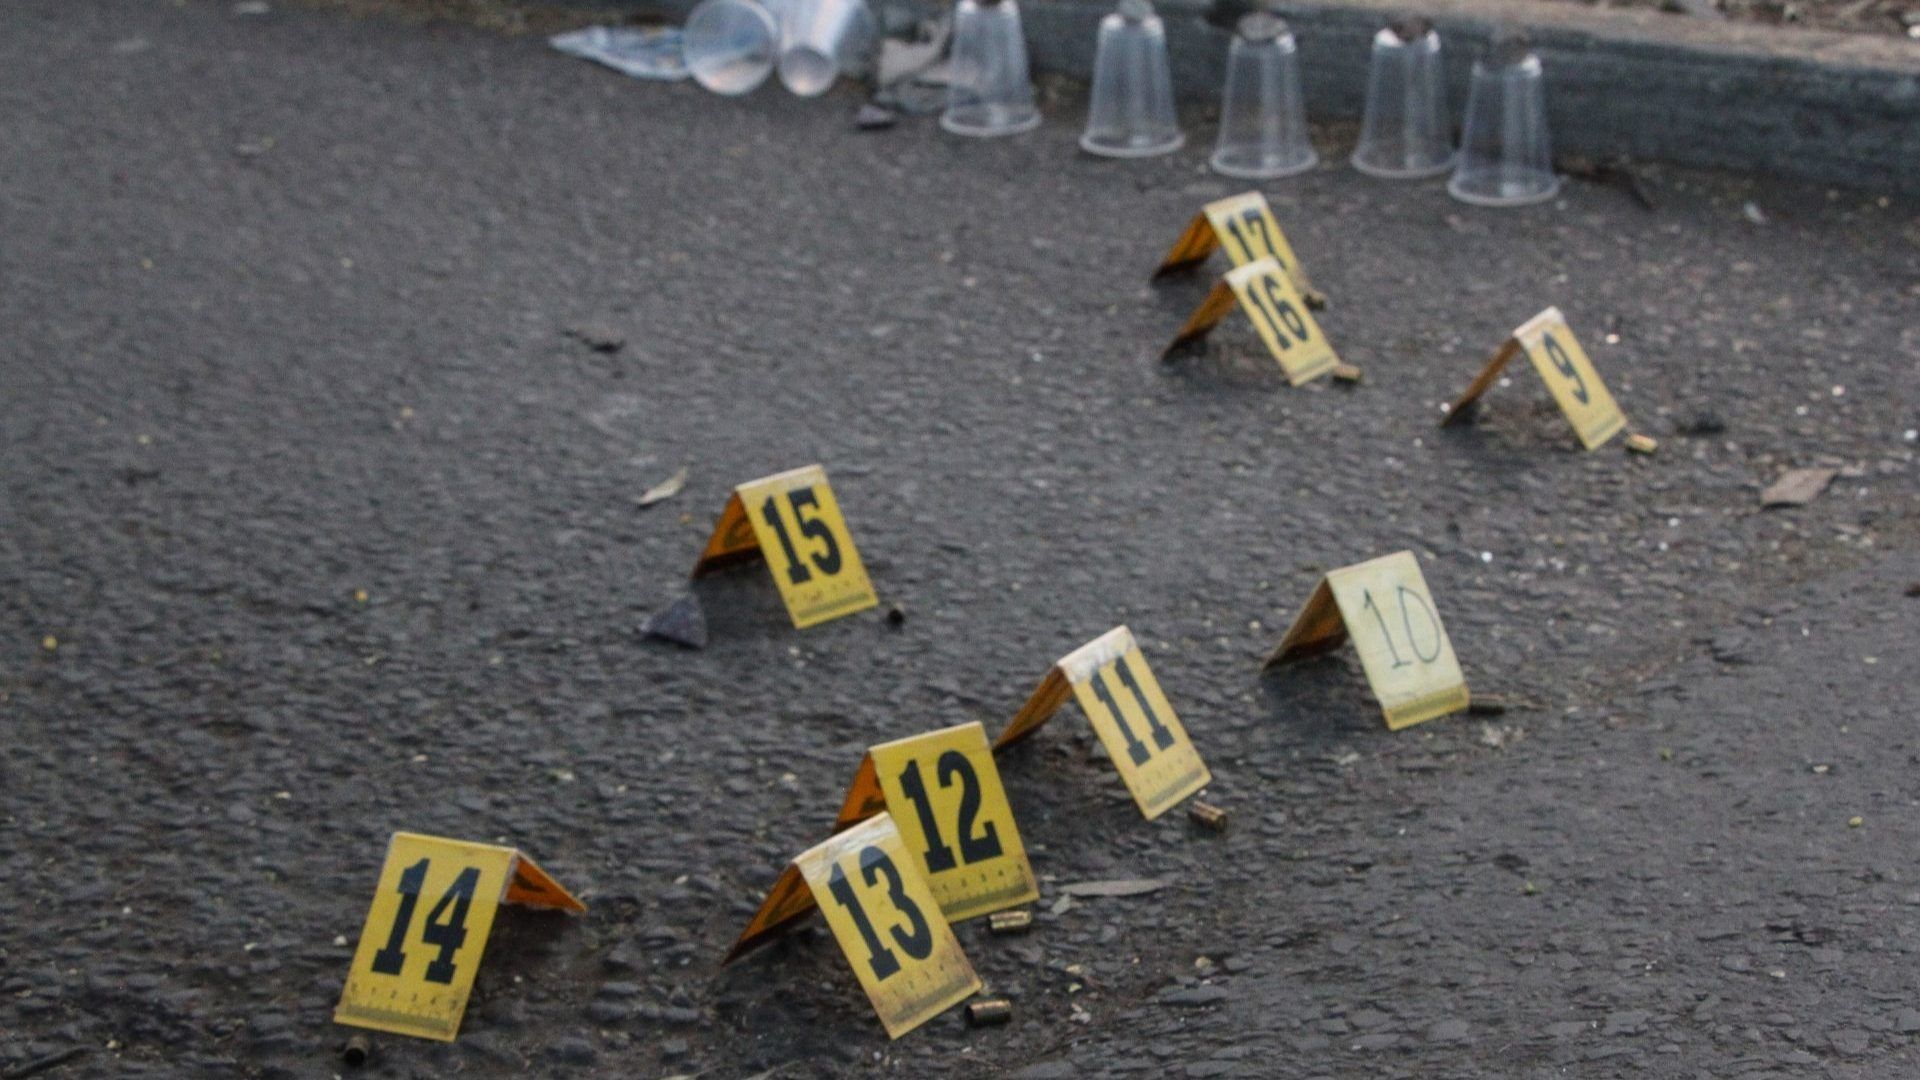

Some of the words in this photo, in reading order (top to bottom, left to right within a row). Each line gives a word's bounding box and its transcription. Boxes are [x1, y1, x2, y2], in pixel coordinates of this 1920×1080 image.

[1227, 208, 1286, 270] 17
[1247, 274, 1307, 349] 16
[1542, 332, 1590, 405] 9
[761, 487, 842, 584] 15
[1364, 585, 1441, 669] 10
[1090, 655, 1175, 767] 11
[899, 750, 1004, 874] 12
[371, 857, 481, 985] 14
[827, 845, 932, 982] 13
